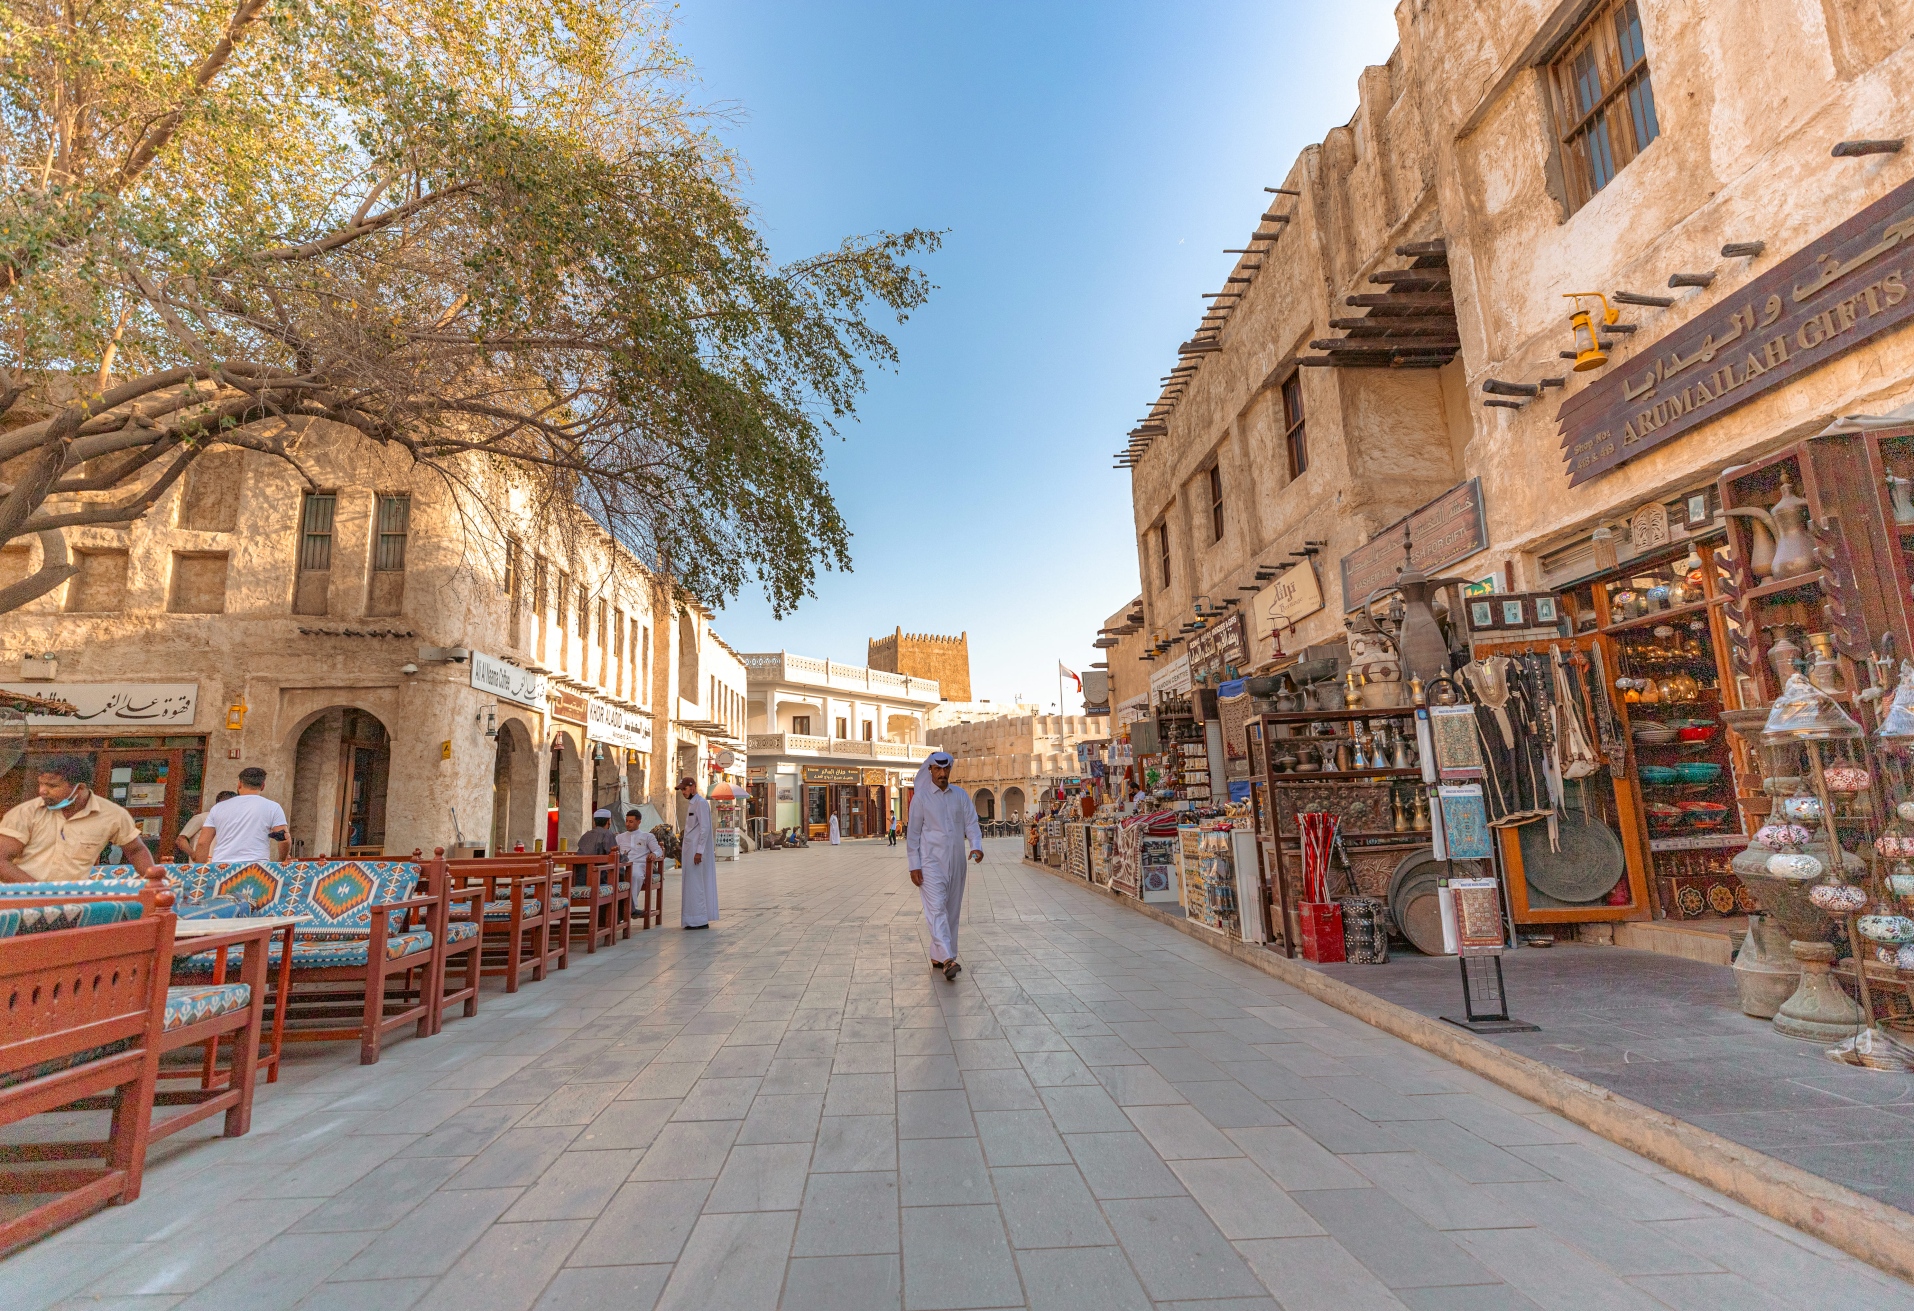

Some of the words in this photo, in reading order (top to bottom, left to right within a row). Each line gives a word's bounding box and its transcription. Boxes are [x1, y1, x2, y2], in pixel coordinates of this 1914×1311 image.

[1622, 333, 1791, 448] ARUMAILAH
[1796, 269, 1908, 349] GIFTS
[1573, 437, 1593, 455] Shop
[1592, 451, 1599, 463] &
[1354, 571, 1382, 592] KASHEM
[1381, 567, 1390, 579] AL
[1427, 540, 1444, 556] FOR
[499, 667, 511, 691] Coffee
[161, 694, 191, 720] قهوة
